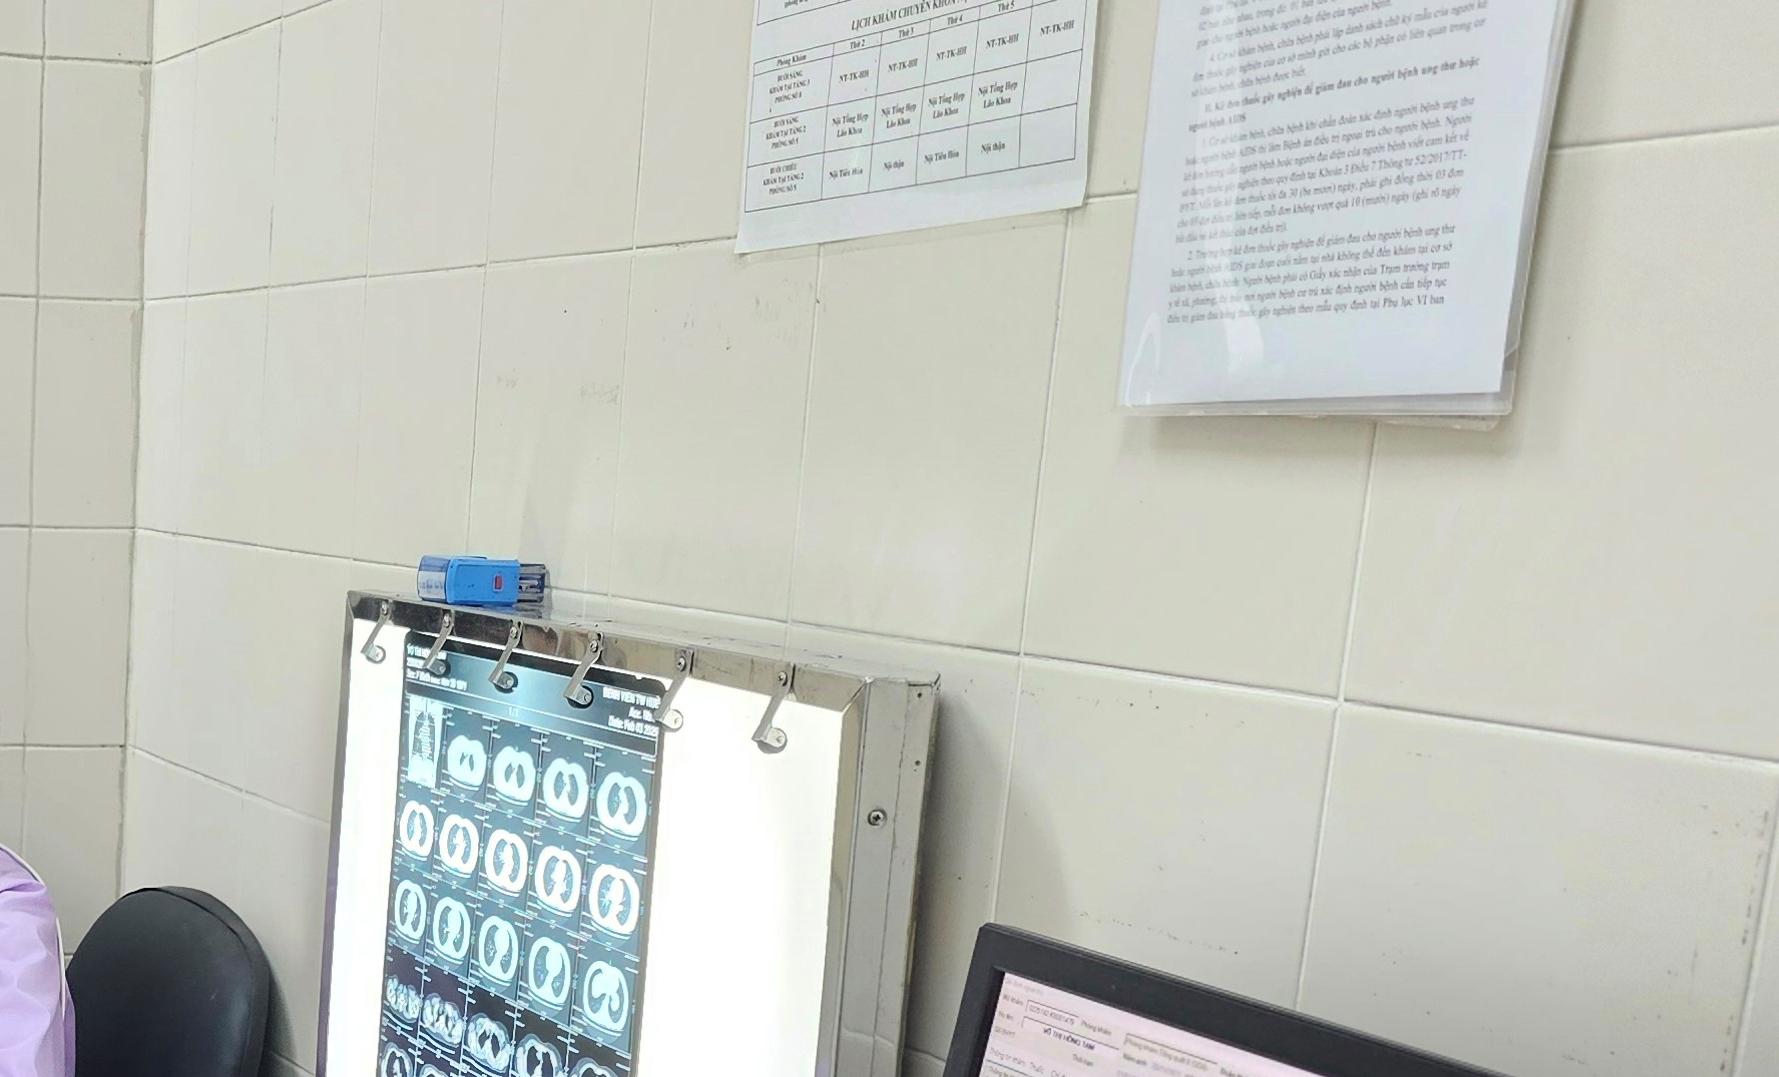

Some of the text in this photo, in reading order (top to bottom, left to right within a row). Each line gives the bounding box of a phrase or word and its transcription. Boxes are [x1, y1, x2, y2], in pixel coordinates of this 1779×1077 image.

[852, 17, 870, 31] LỊCH
[872, 9, 897, 25] KHÁM
[1353, 76, 1368, 87] cho
[1378, 126, 1393, 136] cho
[1351, 197, 1361, 208] 10
[1417, 294, 1427, 306] VI
[1430, 294, 1445, 305] ban
